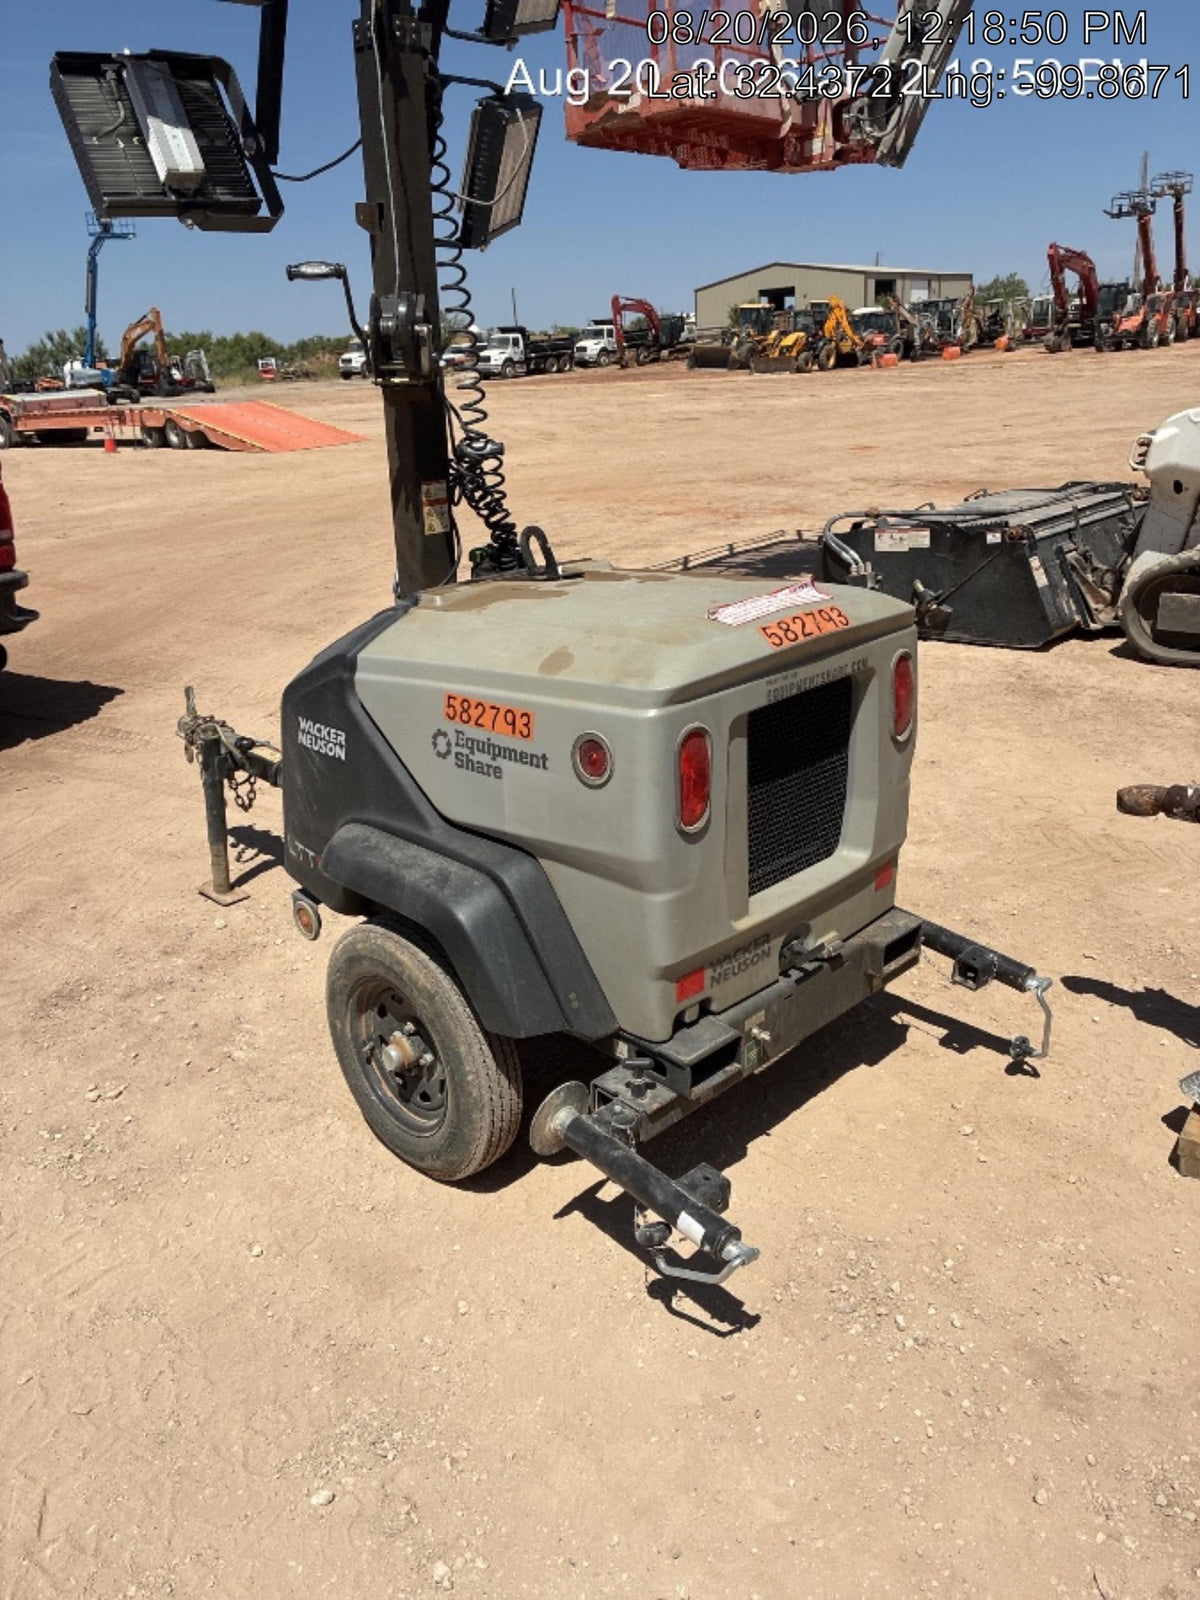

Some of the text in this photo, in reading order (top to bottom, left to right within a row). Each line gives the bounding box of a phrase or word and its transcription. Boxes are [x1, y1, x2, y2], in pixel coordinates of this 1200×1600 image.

[762, 606, 850, 647] 582793
[297, 715, 347, 746] WACKER
[445, 694, 532, 739] 582793
[297, 729, 346, 761] NEUSON
[454, 728, 549, 771] Equipment
[454, 751, 503, 780] Share
[287, 834, 323, 869] LTT
[710, 932, 771, 973] WACKER
[710, 945, 772, 989] NEUSON
